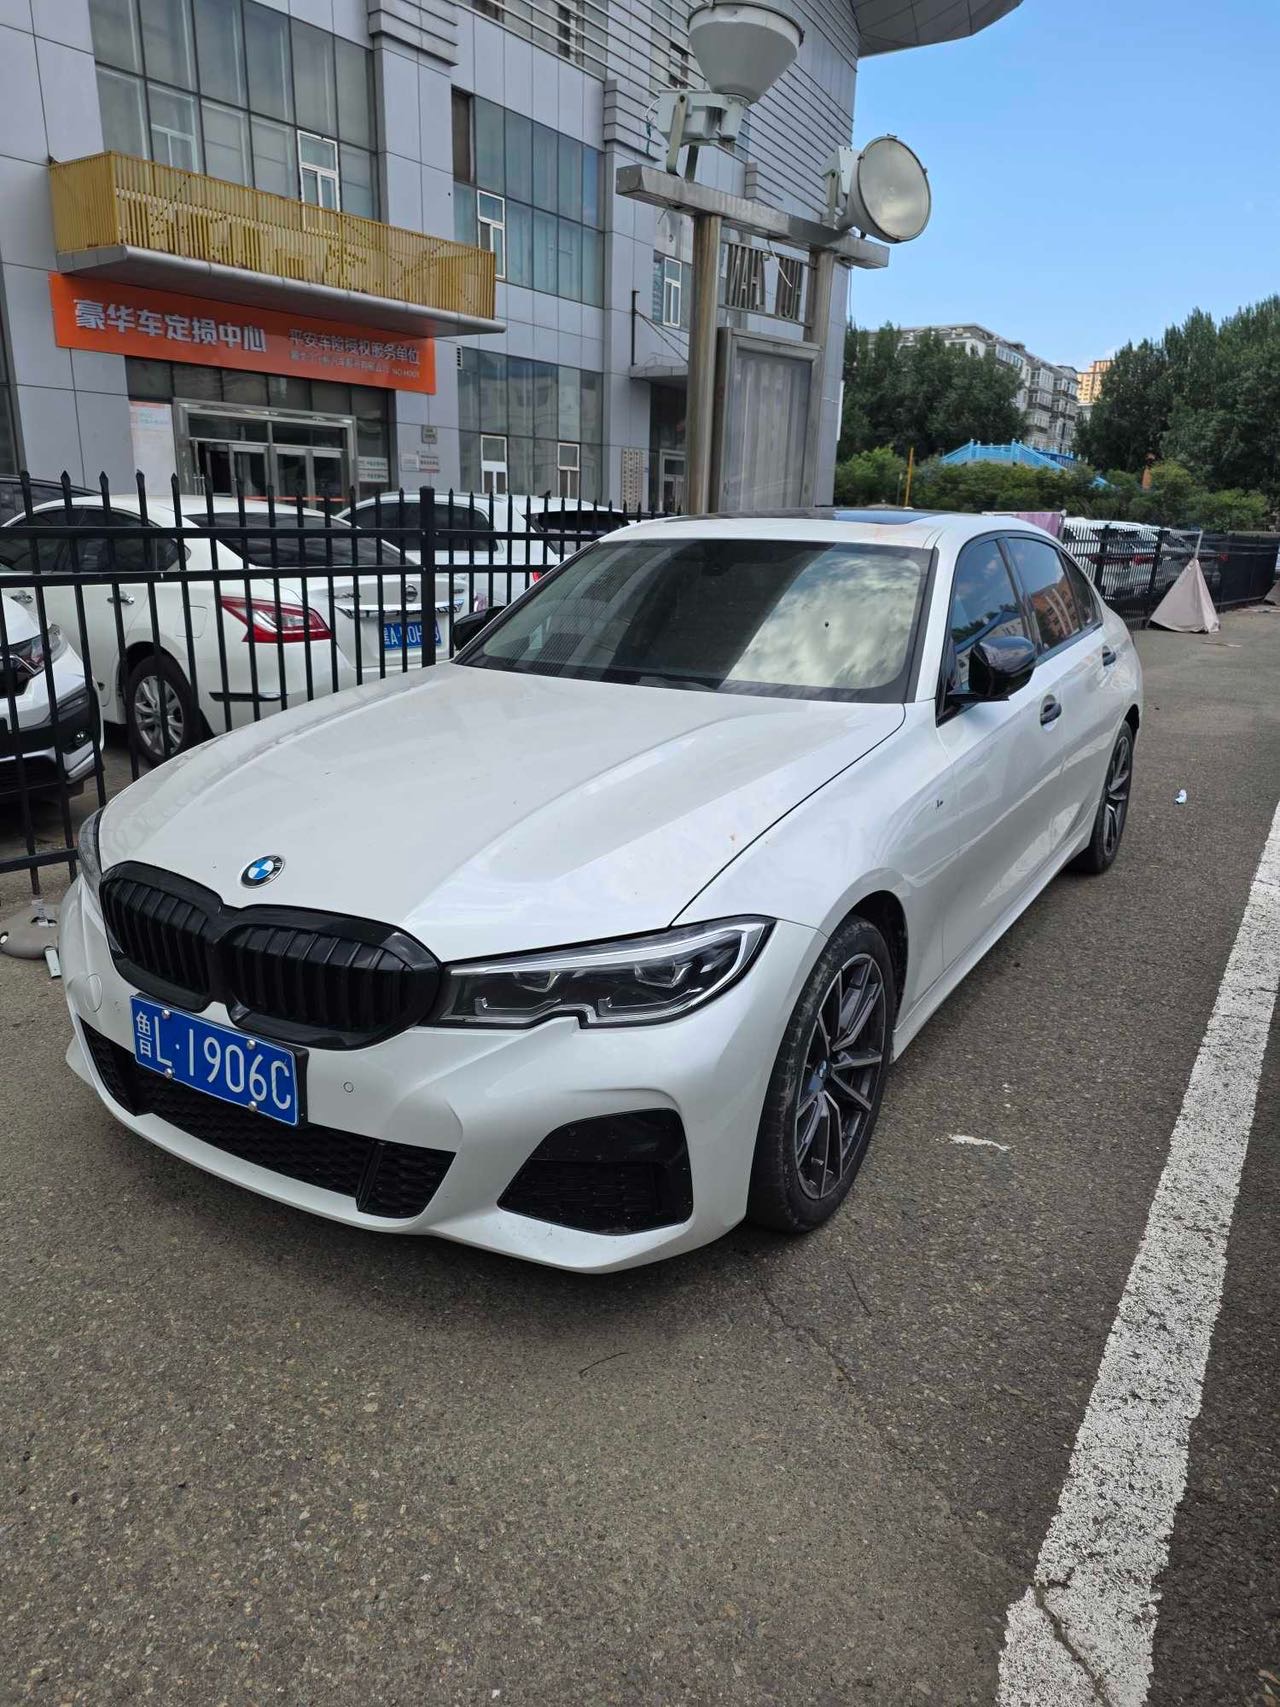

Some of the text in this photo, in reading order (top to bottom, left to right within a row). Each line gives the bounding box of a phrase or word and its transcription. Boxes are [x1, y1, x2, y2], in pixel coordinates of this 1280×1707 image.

[74, 299, 267, 352] 豪华车定损中心
[288, 328, 420, 365] 平安车险授权服务单位
[136, 1011, 292, 1110] 鲁L·1906C
